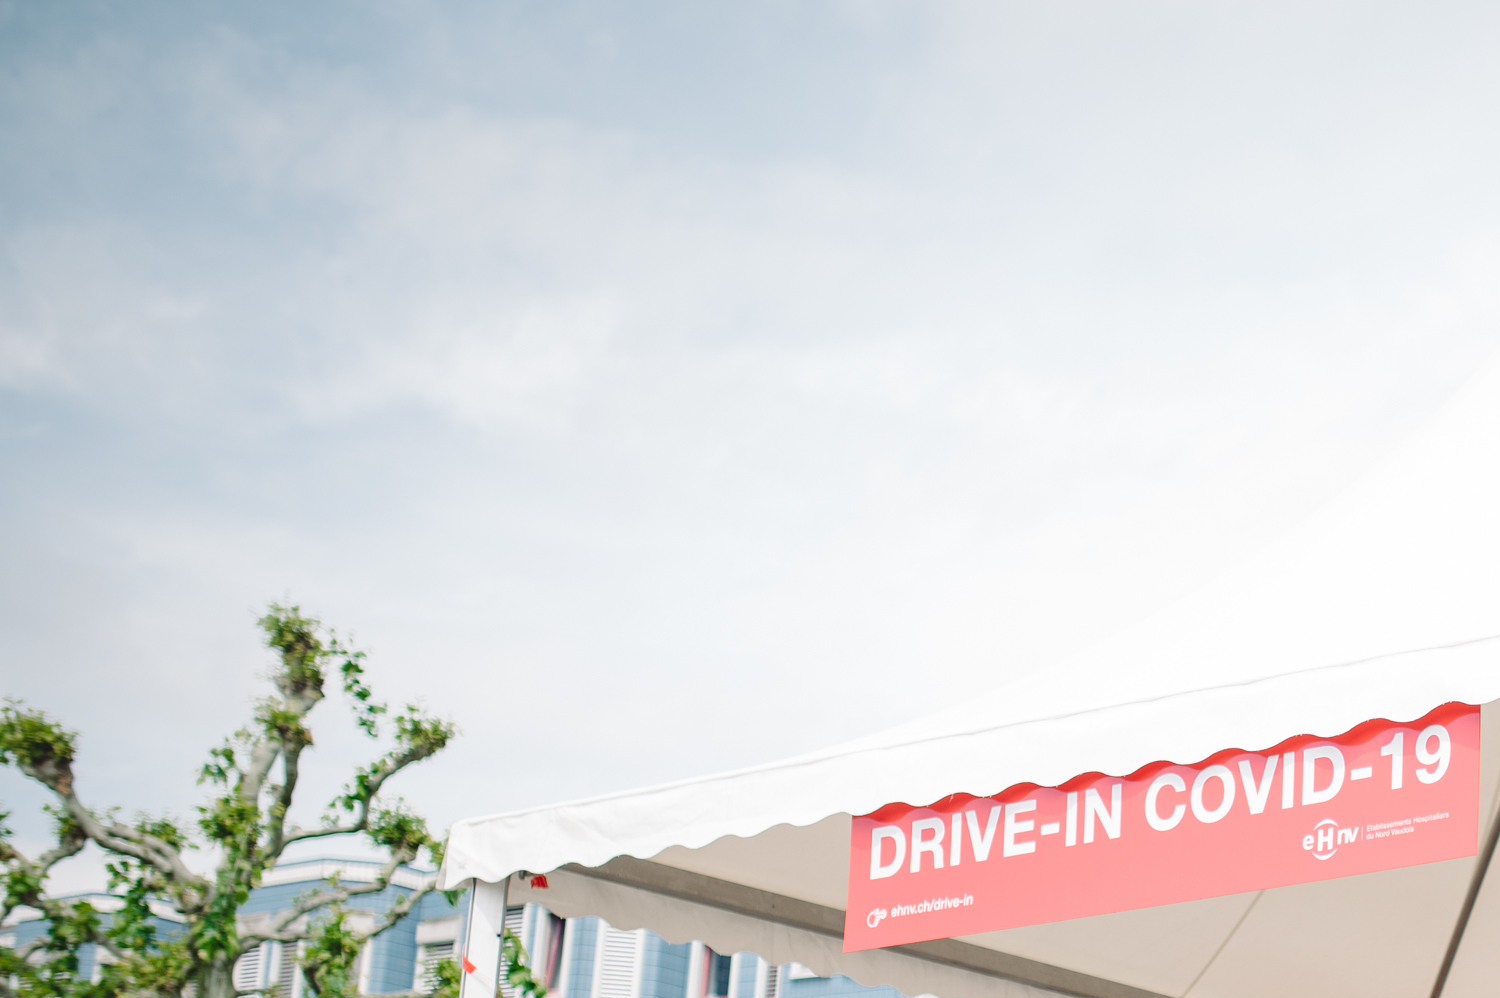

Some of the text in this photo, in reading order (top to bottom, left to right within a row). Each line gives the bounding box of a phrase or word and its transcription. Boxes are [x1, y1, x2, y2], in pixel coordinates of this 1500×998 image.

[869, 724, 1451, 880] DRIVE-IN COVID-19
[1366, 812, 1449, 832] Etablissements Hospitaliers
[1366, 826, 1414, 840] du Nord Vaudois
[1302, 826, 1359, 852] eHnv
[890, 893, 974, 918] ehnv.ch/drive-in
